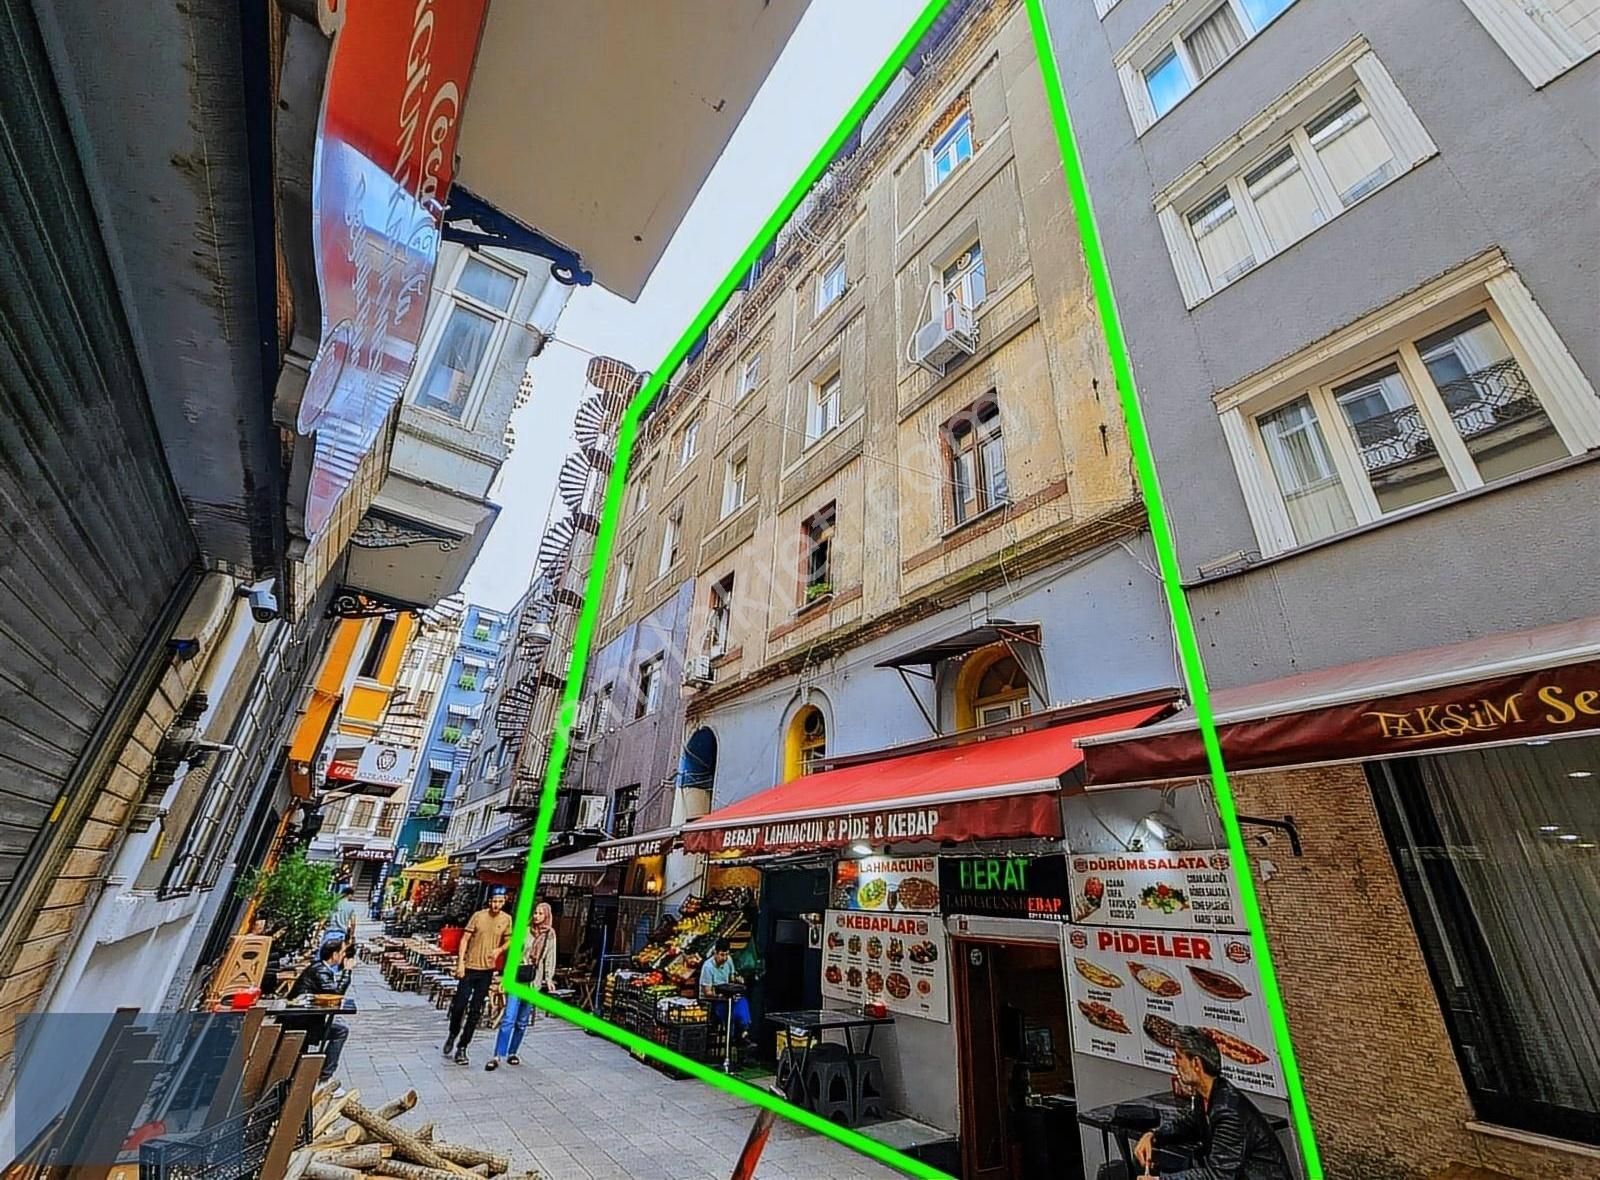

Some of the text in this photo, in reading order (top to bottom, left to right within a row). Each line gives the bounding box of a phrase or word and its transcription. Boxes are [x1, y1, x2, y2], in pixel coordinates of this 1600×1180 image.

[722, 810, 939, 848] BERAT LAHMACUN & PİDE & KEBAP
[858, 858, 924, 874] LAHMACUN
[960, 858, 1029, 891] BERAT
[846, 915, 916, 935] KEBAPLAR
